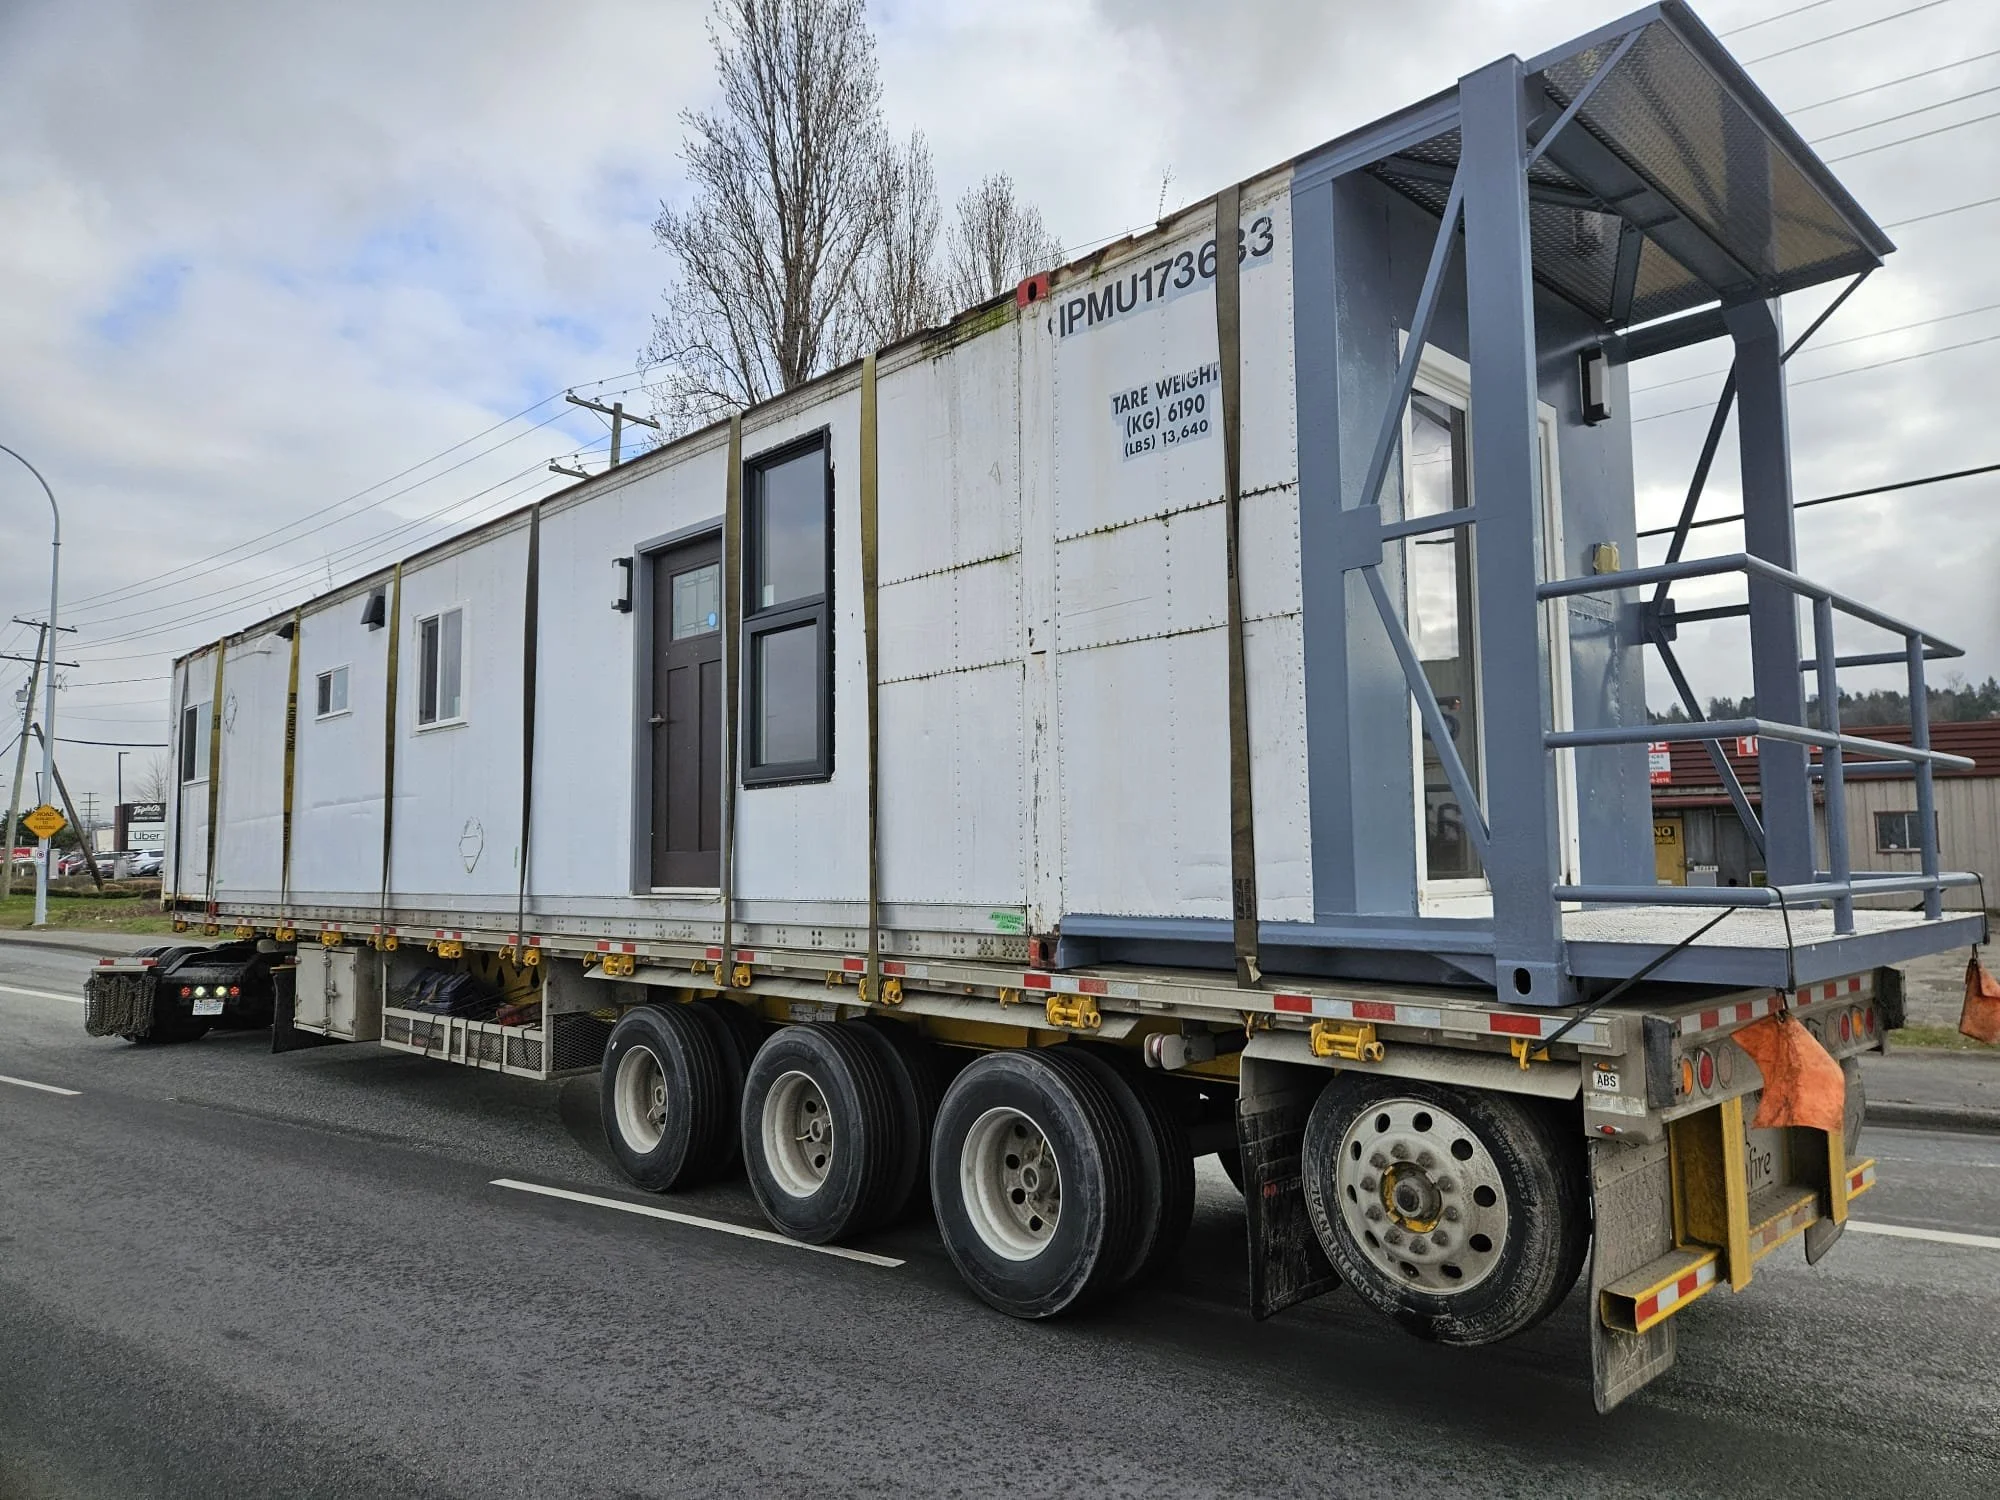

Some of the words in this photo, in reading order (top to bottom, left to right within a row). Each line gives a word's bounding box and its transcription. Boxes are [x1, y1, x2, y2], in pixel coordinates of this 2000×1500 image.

[1112, 386, 1149, 415] TARE
[1155, 360, 1220, 400] WEIGHT
[1126, 406, 1160, 438] (KG)
[1167, 393, 1205, 422] 6190
[1124, 434, 1156, 458] (LBS)
[1161, 419, 1209, 445] 13,640
[285, 706, 298, 753] KINEDYNE
[133, 831, 161, 841] Uber
[1597, 1073, 1617, 1088] ABS
